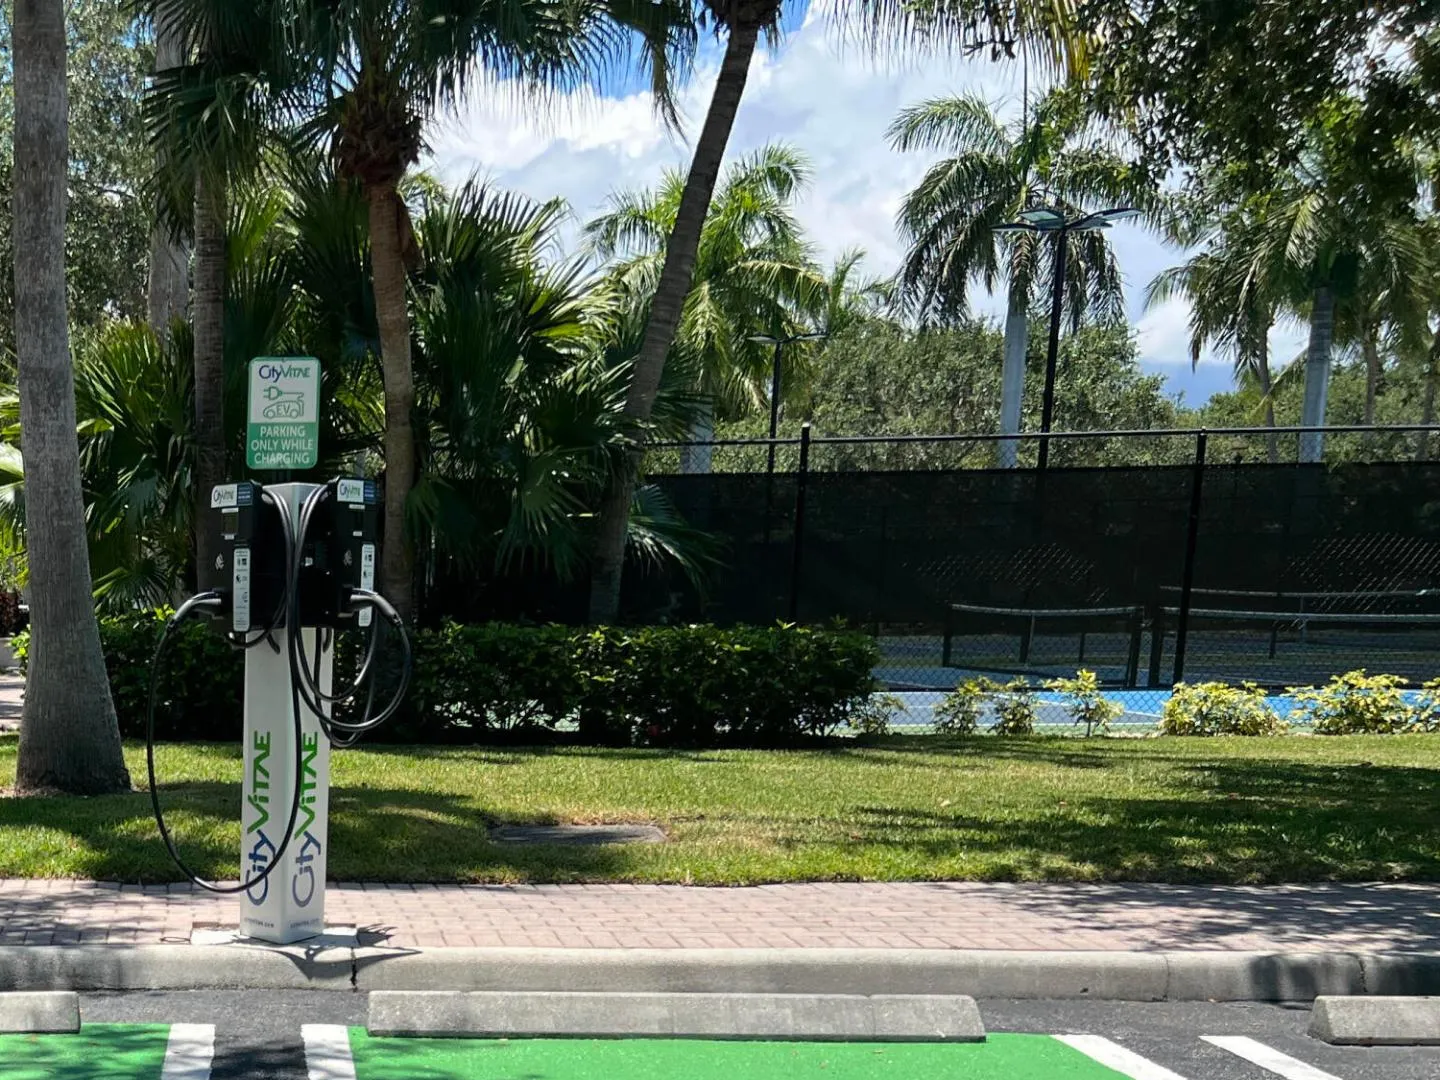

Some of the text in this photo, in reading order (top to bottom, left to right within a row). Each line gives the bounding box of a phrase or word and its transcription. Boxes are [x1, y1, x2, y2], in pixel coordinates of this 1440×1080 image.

[276, 403, 291, 416] EV
[260, 425, 306, 437] PARKING
[250, 439, 314, 451] ONLY WHILE
[254, 452, 311, 464] CHARGING
